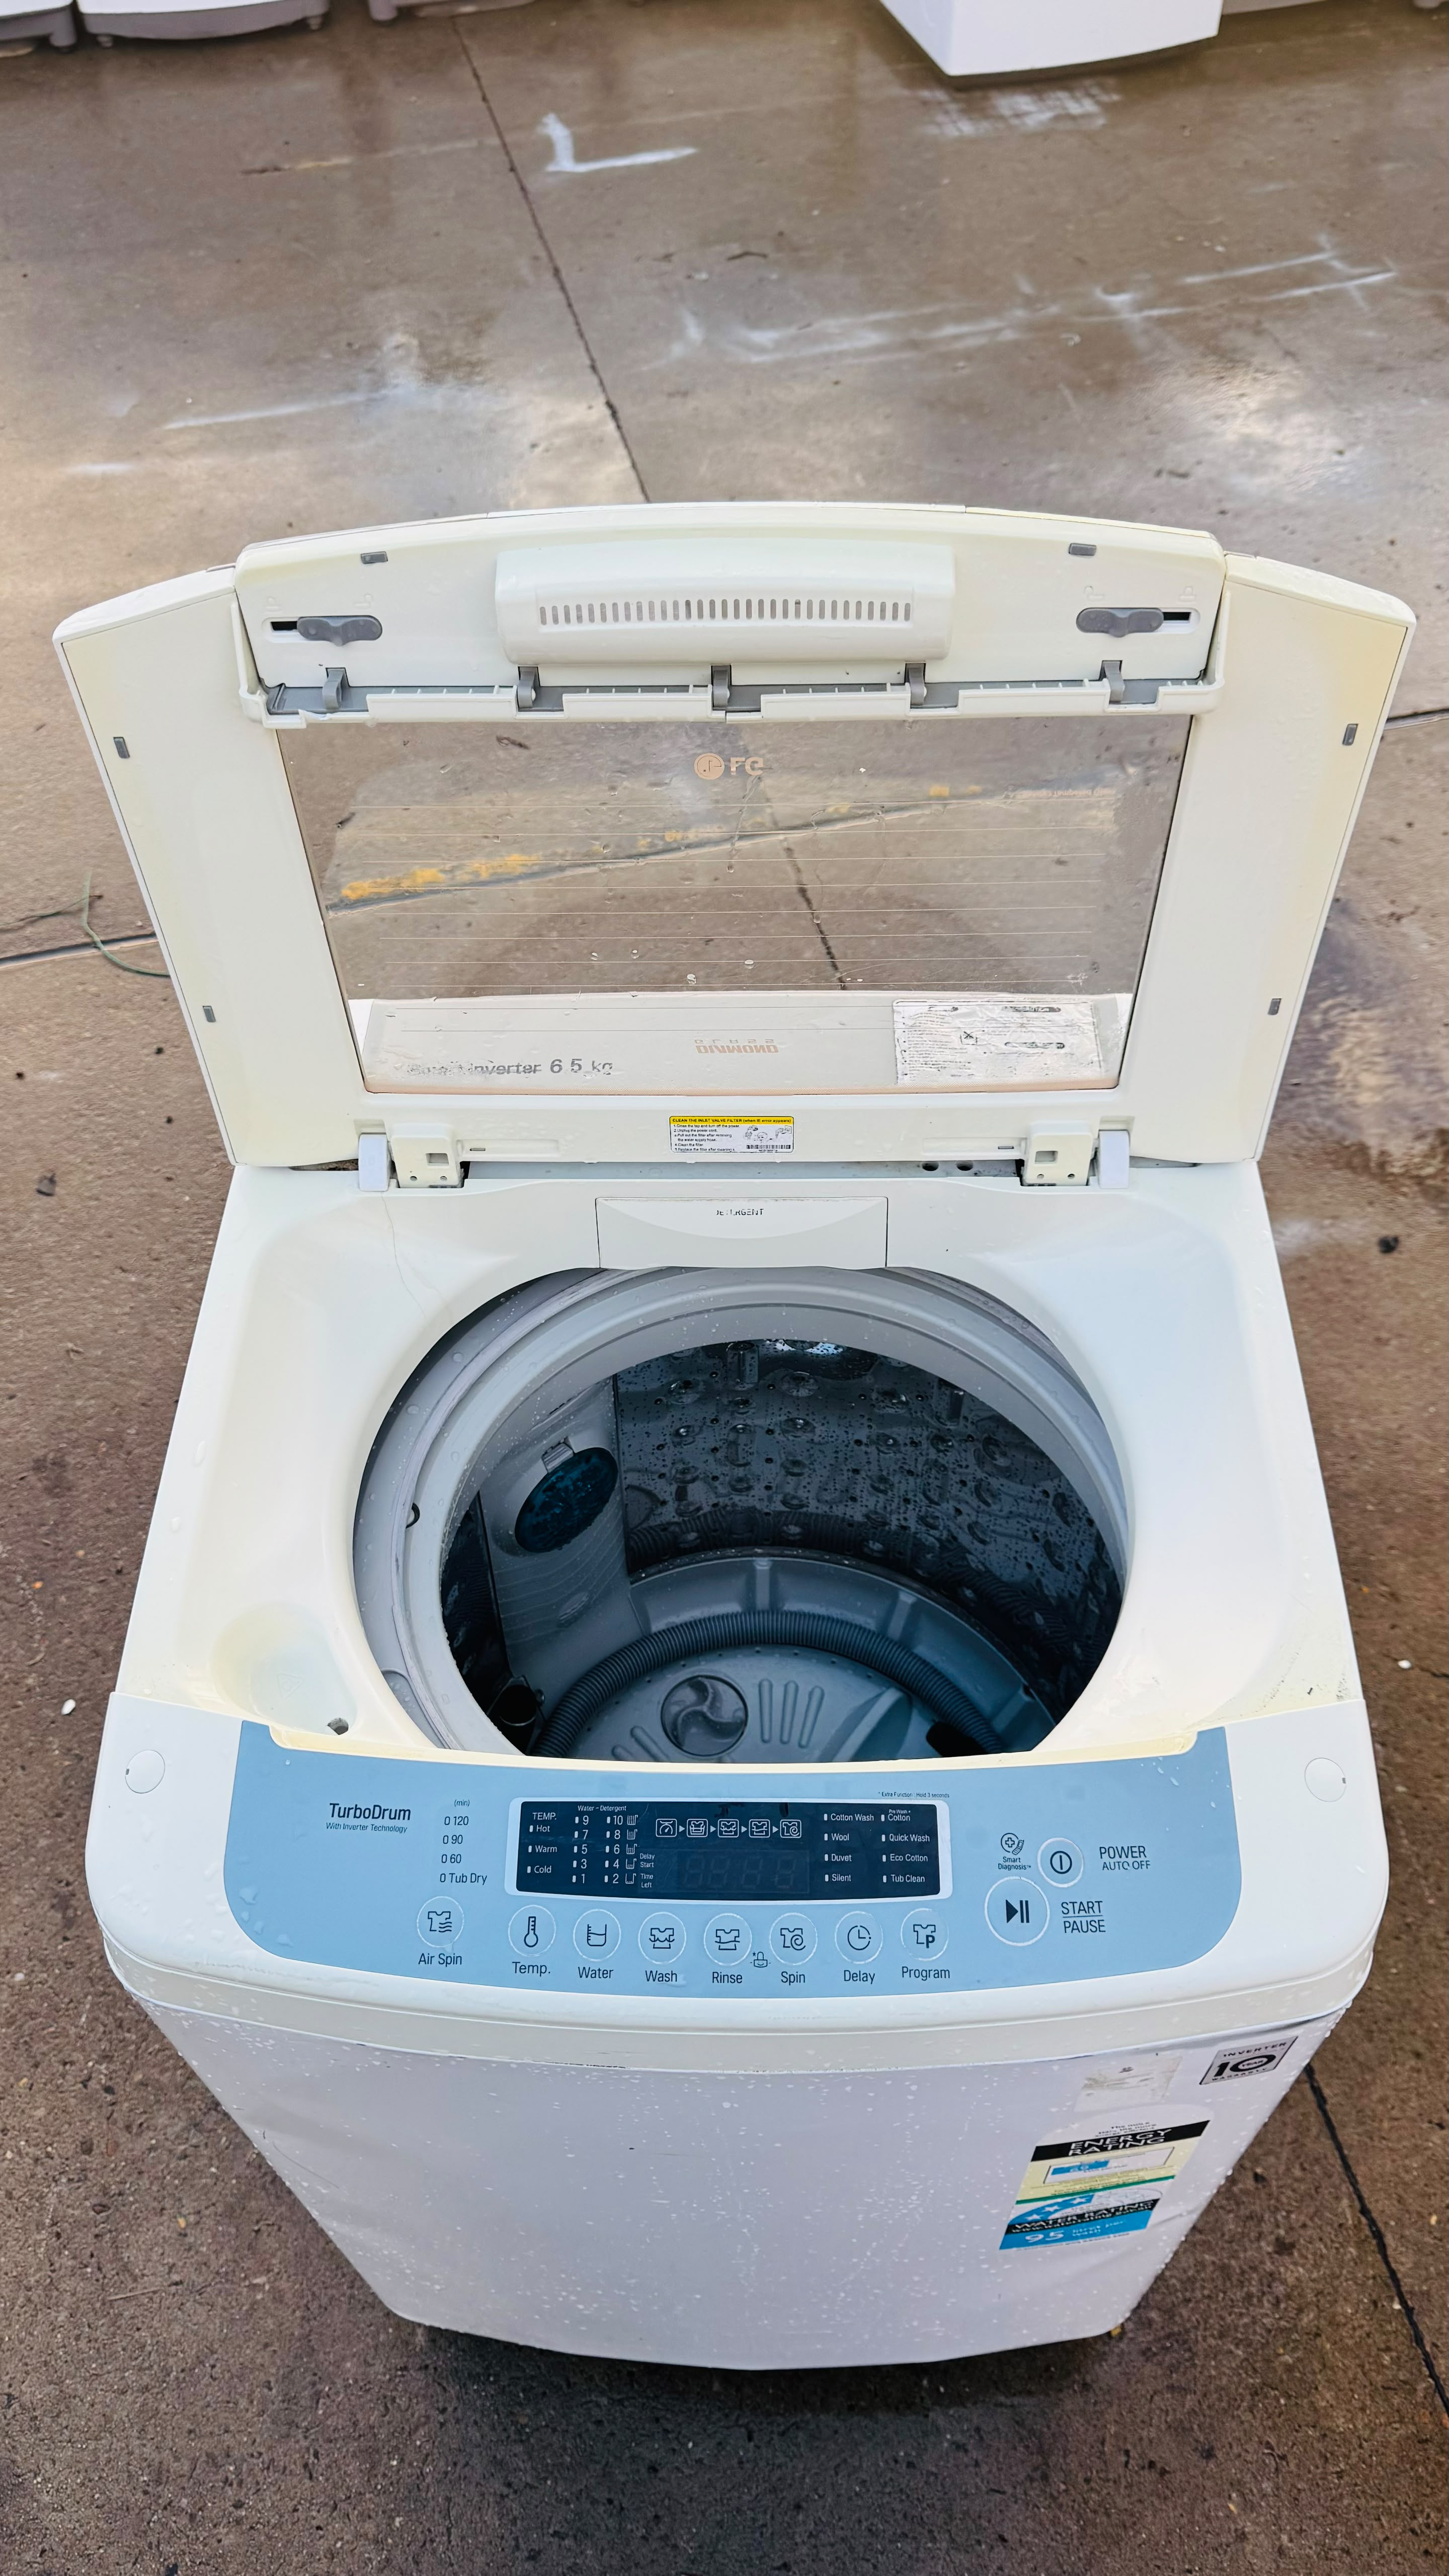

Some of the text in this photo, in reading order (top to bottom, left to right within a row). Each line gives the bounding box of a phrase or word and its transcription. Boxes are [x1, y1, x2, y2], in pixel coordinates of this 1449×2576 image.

[469, 1060, 542, 1075] nverter
[454, 1799, 470, 1807] (min)
[330, 1803, 411, 1821] TurboDrum
[600, 1805, 626, 1813] Detergent
[453, 1816, 469, 1826] 120
[532, 1812, 557, 1820] TEMP.
[583, 1816, 623, 1825] 9 10
[855, 1814, 874, 1822] Wash
[326, 1822, 408, 1833] With Inverter Technology
[536, 1825, 550, 1833] Hot
[451, 1834, 463, 1844] 90
[583, 1830, 620, 1839] 7 8
[889, 1834, 909, 1842] Quick
[535, 1845, 557, 1853] Warm
[581, 1845, 620, 1854] 5 6
[1099, 1846, 1147, 1859] POWER
[450, 1854, 461, 1864] 60
[831, 1854, 852, 1862] Duvet
[890, 1854, 904, 1862] Eco
[581, 1860, 619, 1869] 3 4
[1102, 1861, 1151, 1871] AUTO OFF
[449, 1873, 488, 1885] Tub Dry
[581, 1874, 619, 1884] 1 2
[891, 1875, 904, 1883] Tub
[1061, 1901, 1103, 1914] START
[1064, 1920, 1106, 1933] PAUSE
[419, 1953, 462, 1967] Air Spin
[512, 1962, 551, 1977] Temp.
[578, 1967, 614, 1979] Water
[902, 1967, 950, 1981] Program
[645, 1970, 678, 1982] Wash
[712, 1972, 743, 1984] Rinse
[781, 1971, 806, 1986] Spin
[844, 1970, 875, 1984] Delay
[1214, 2054, 1276, 2077] 10
[1071, 2129, 1172, 2149] ENERGY
[1069, 2137, 1165, 2156] RATING
[1015, 2214, 1077, 2228] WATER
[1025, 2230, 1064, 2242] 95
